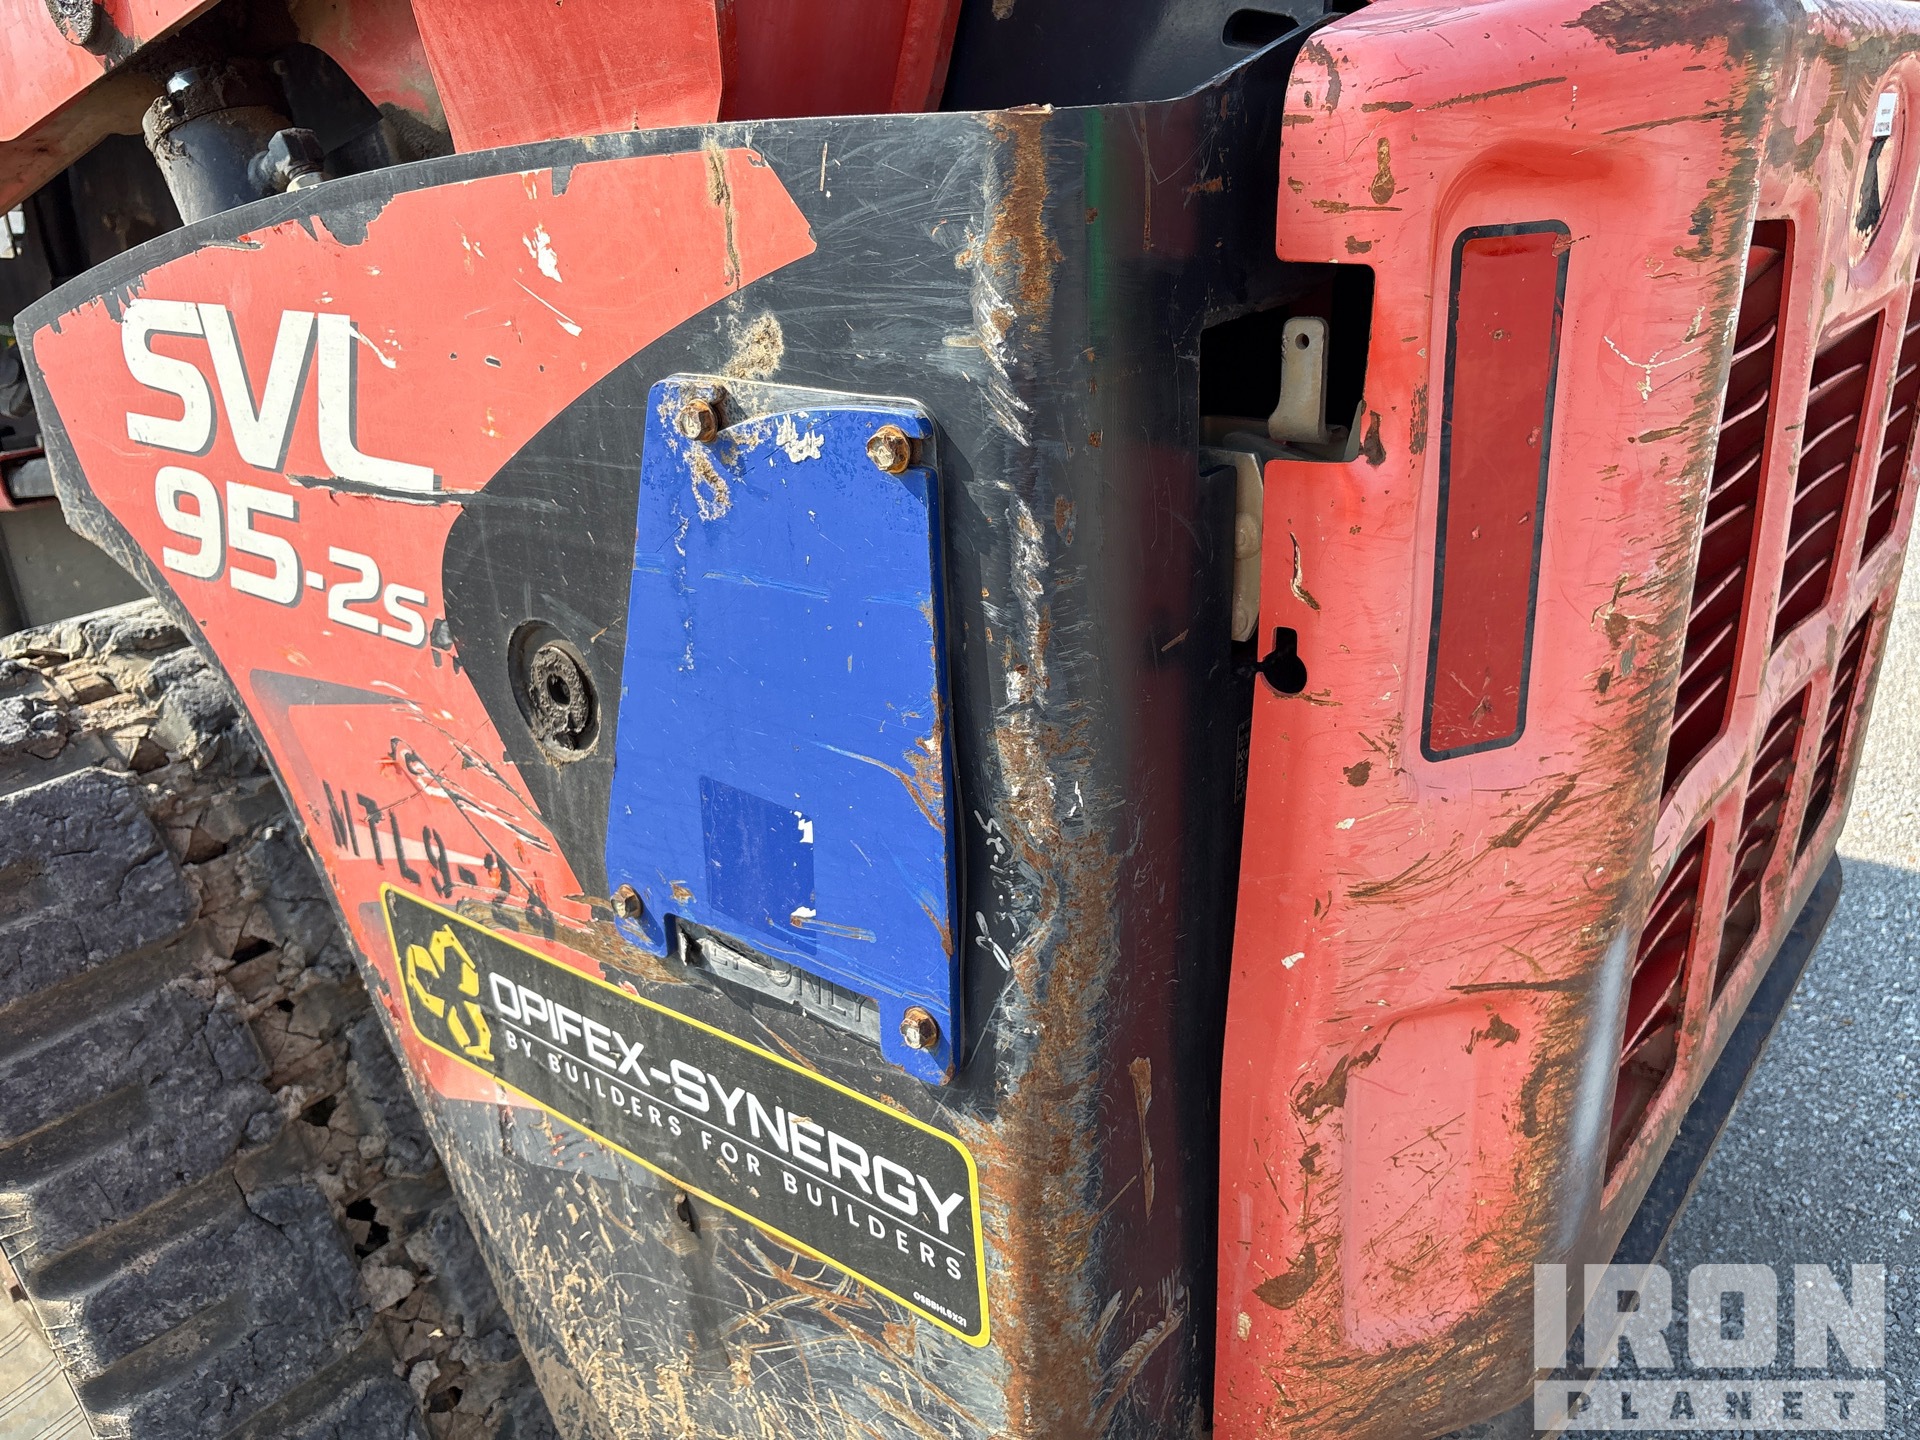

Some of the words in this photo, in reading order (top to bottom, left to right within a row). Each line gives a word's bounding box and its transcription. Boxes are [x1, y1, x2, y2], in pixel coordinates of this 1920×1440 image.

[121, 298, 438, 491] SVL
[488, 971, 964, 1234] OPIFEX-SYNERGY
[505, 1030, 531, 1058] BY
[548, 1053, 681, 1136] BUILDERS
[701, 1131, 761, 1176] FOR
[783, 1172, 961, 1280] BUILDERS
